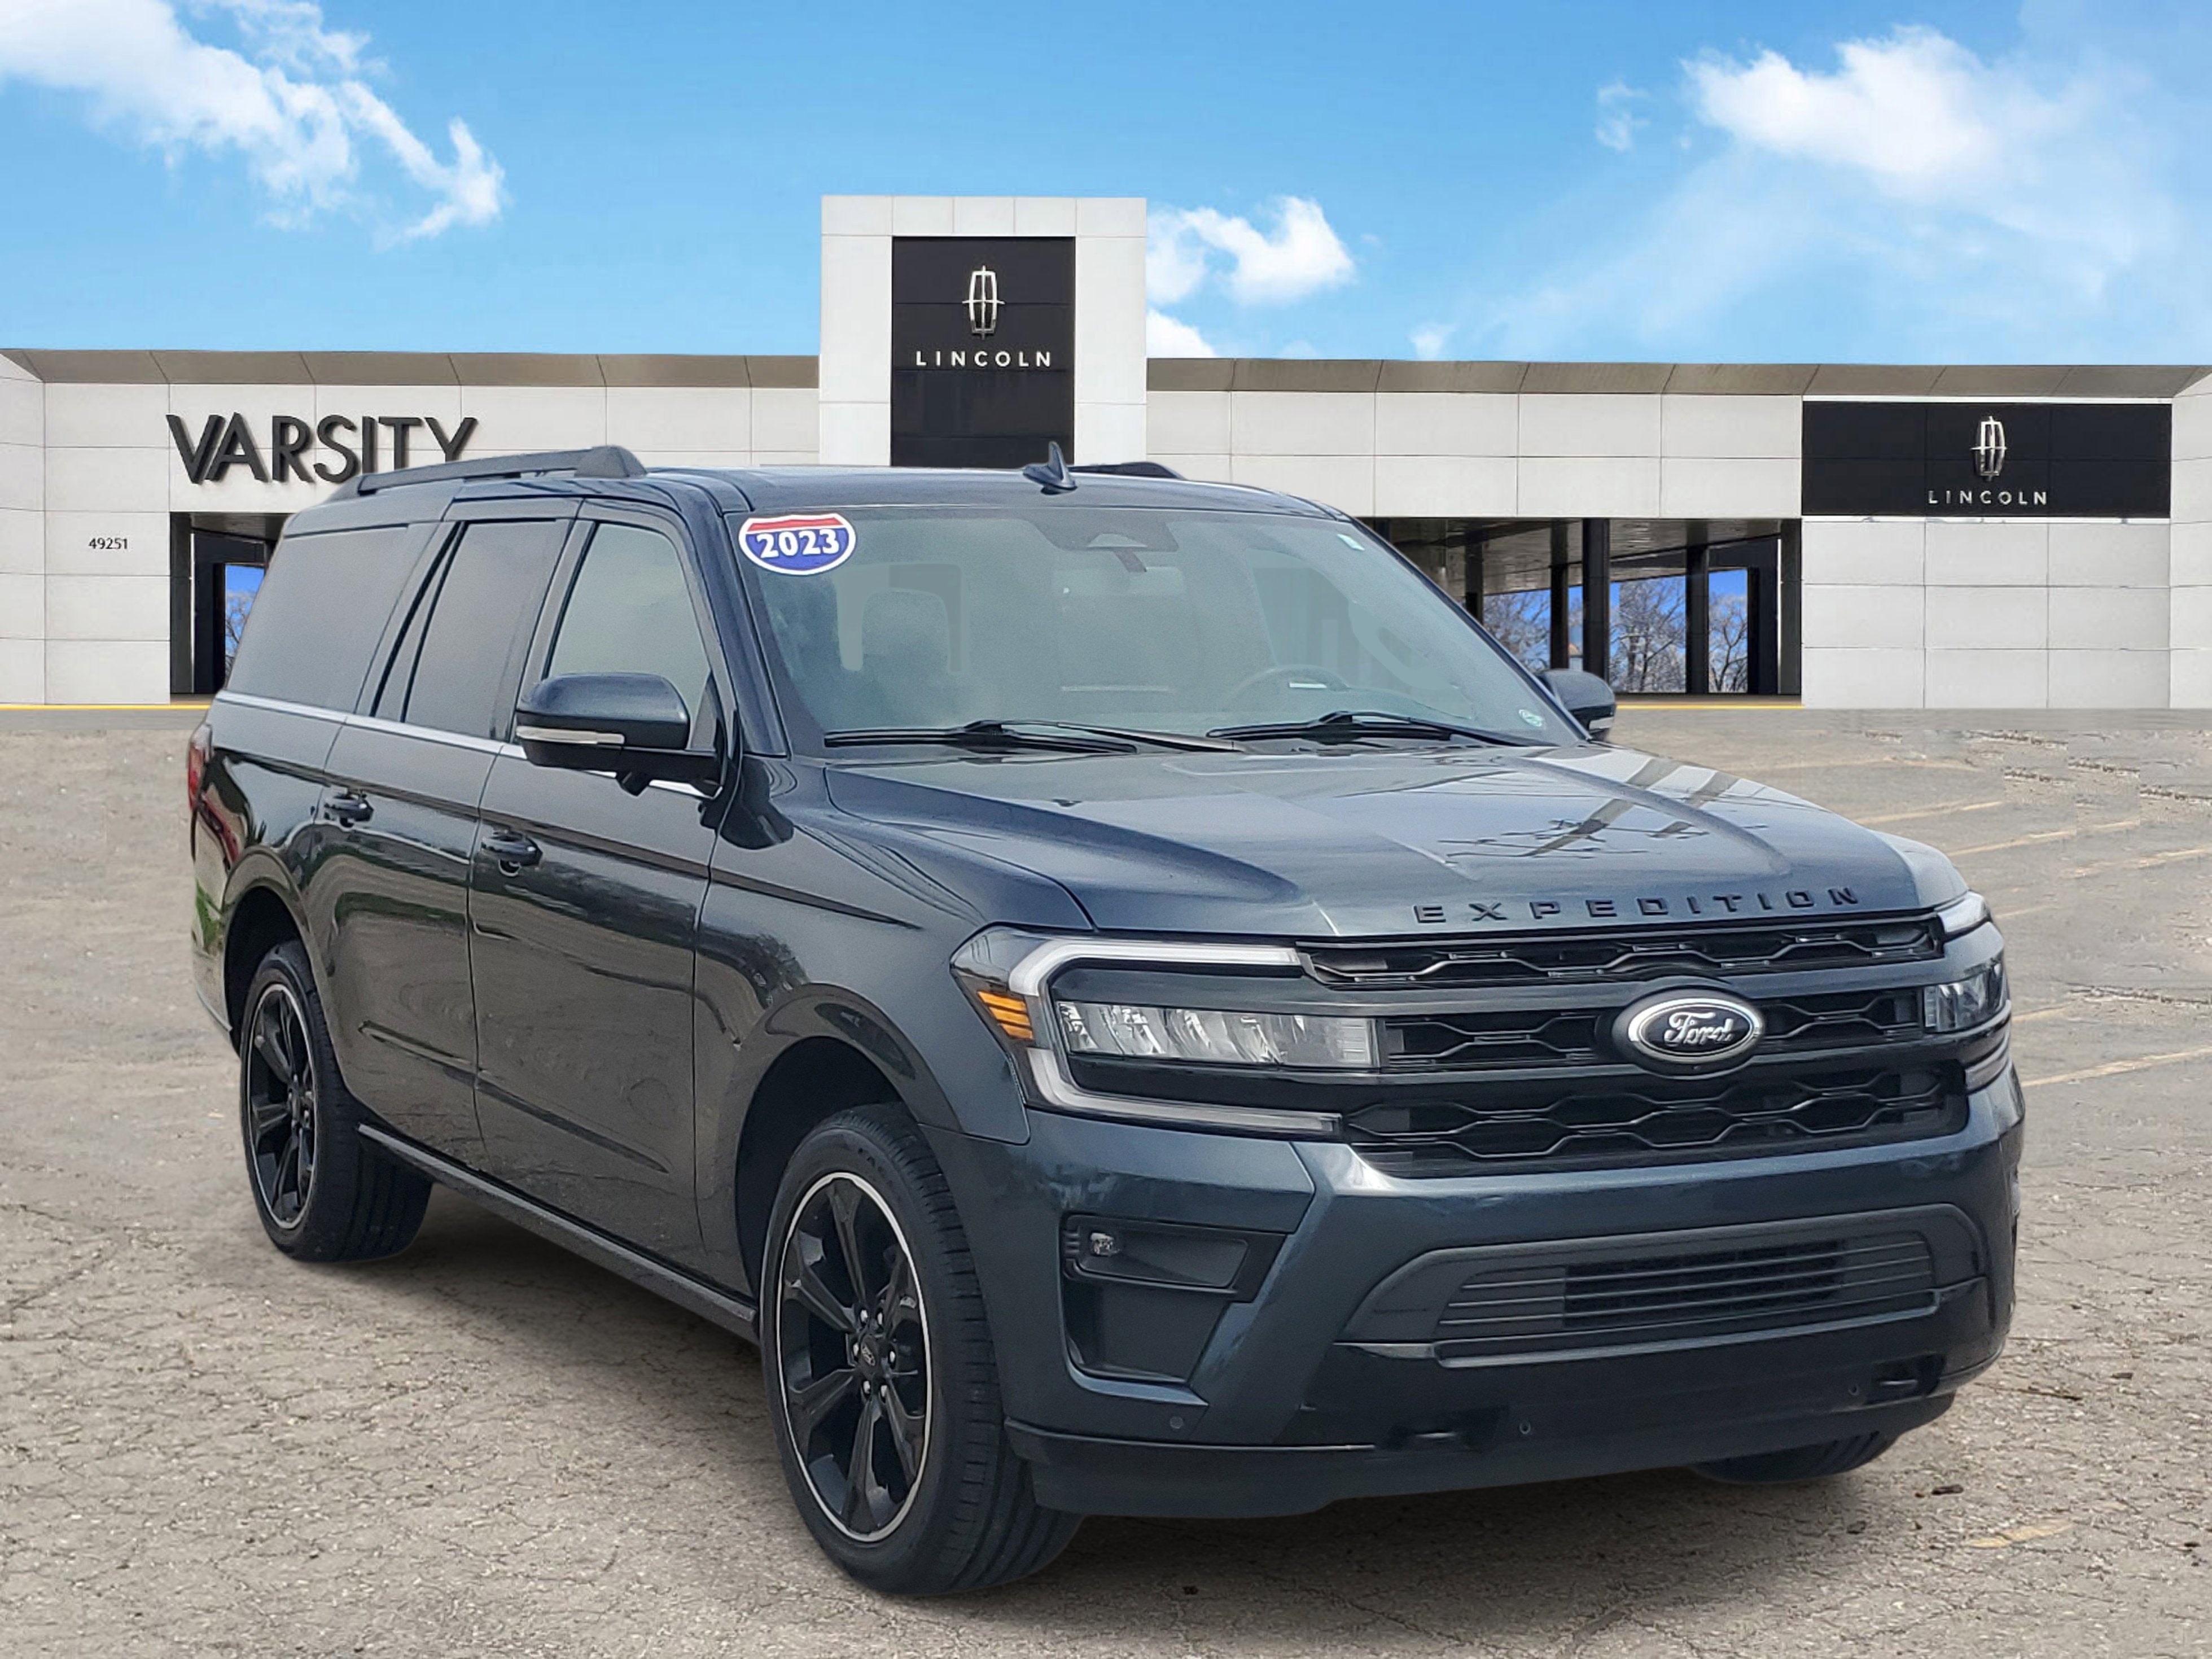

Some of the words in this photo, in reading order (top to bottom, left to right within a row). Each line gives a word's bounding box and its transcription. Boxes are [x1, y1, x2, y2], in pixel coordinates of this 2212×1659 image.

[916, 351, 1052, 367] LINCOLN
[165, 413, 478, 484] VARSITY
[1929, 490, 2048, 506] LINCOLN
[88, 537, 128, 549] 49251
[756, 528, 840, 558] 2023
[1413, 886, 1860, 925] EXPEDITION
[1664, 1012, 1734, 1047] Ford
